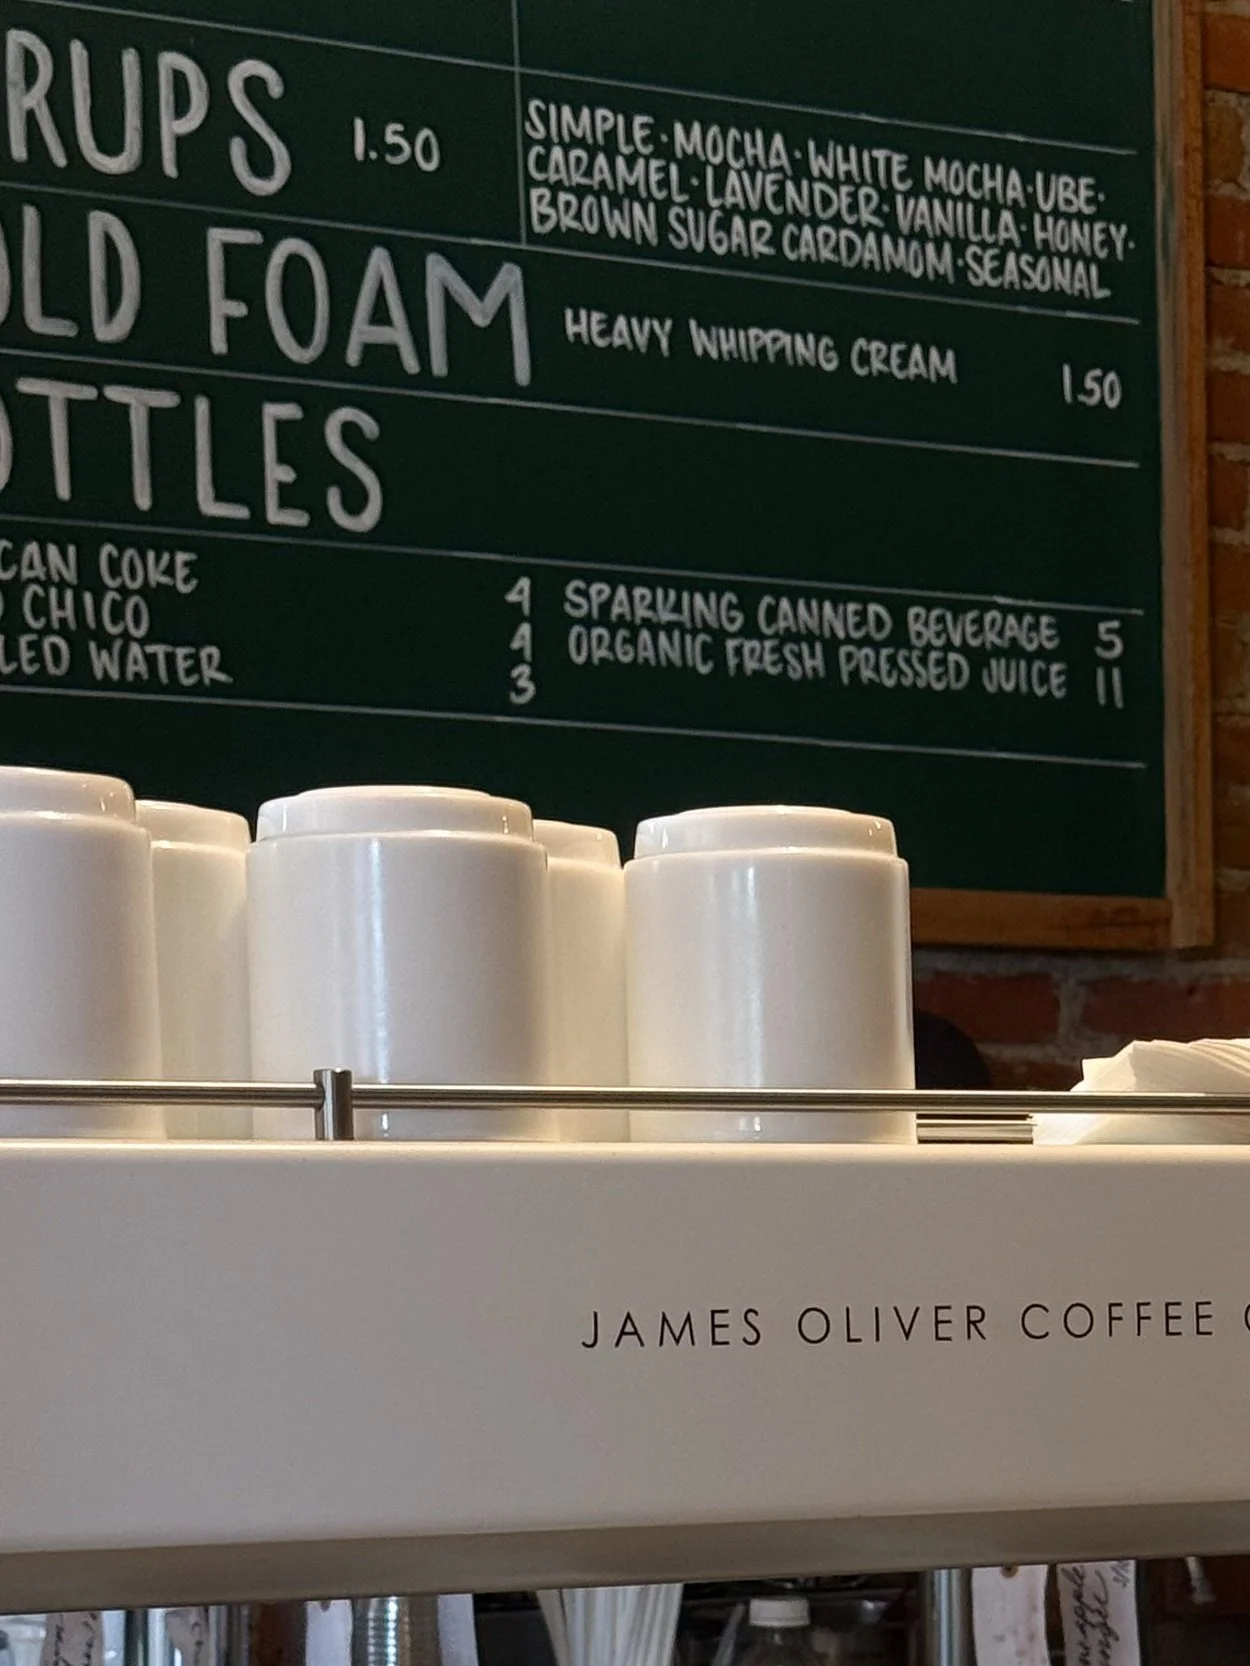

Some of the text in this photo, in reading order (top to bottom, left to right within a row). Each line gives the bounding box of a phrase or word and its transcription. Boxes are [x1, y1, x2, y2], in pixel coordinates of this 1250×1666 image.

[6, 28, 440, 196] RUPS 1.50
[525, 99, 1097, 215] SIMPLE MOCHA WHITE MOCHA UBE
[527, 145, 1129, 261] CARAMEL LAVENDER VANILLA HONEY
[530, 187, 658, 247] BROWN
[668, 205, 776, 259] SUGAR
[965, 244, 1111, 300] SEASONAL
[0, 204, 531, 387] LD FOAM
[564, 307, 673, 357] HEAVY
[689, 318, 839, 372] WHIPPING
[850, 337, 957, 384] CREAM
[0, 376, 383, 533] TTLES
[99, 542, 199, 594] COKE
[22, 583, 150, 639] CHICO
[505, 577, 532, 616] 4
[757, 595, 892, 641] CANNED
[907, 606, 1060, 651] BEVERAGE
[1095, 619, 1123, 659] 5
[88, 640, 234, 688] WATER
[510, 622, 1124, 710] 4 ORGANIC FRESH PRESSED JUICE 11
[510, 664, 536, 704] 3
[582, 1308, 761, 1349] JAMES
[798, 1305, 986, 1345] OLIVER
[1021, 1301, 1213, 1340] COFFEE
